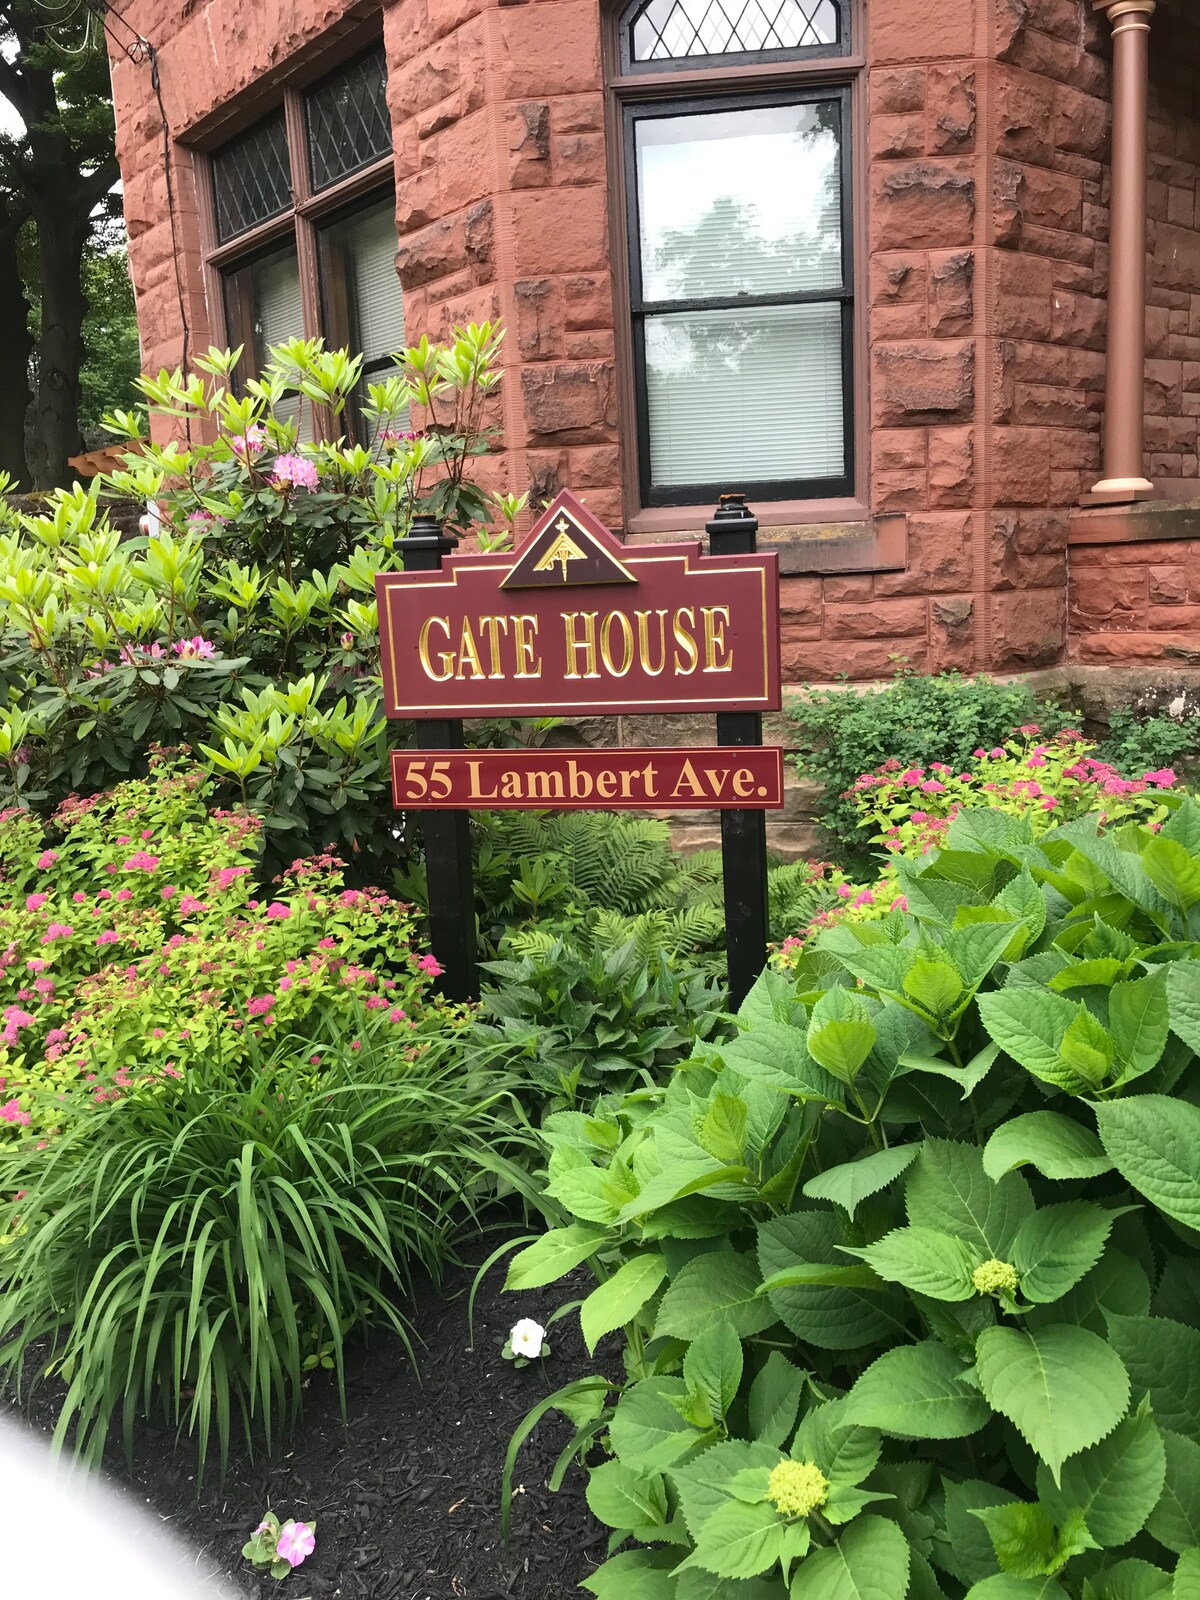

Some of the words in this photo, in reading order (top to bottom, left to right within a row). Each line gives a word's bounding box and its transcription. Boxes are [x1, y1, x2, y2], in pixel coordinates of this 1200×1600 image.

[418, 612, 542, 682] GATE
[560, 605, 734, 680] HOUSE
[405, 761, 453, 799] 55
[465, 760, 659, 799] Lambert
[670, 758, 768, 798] Ave.
